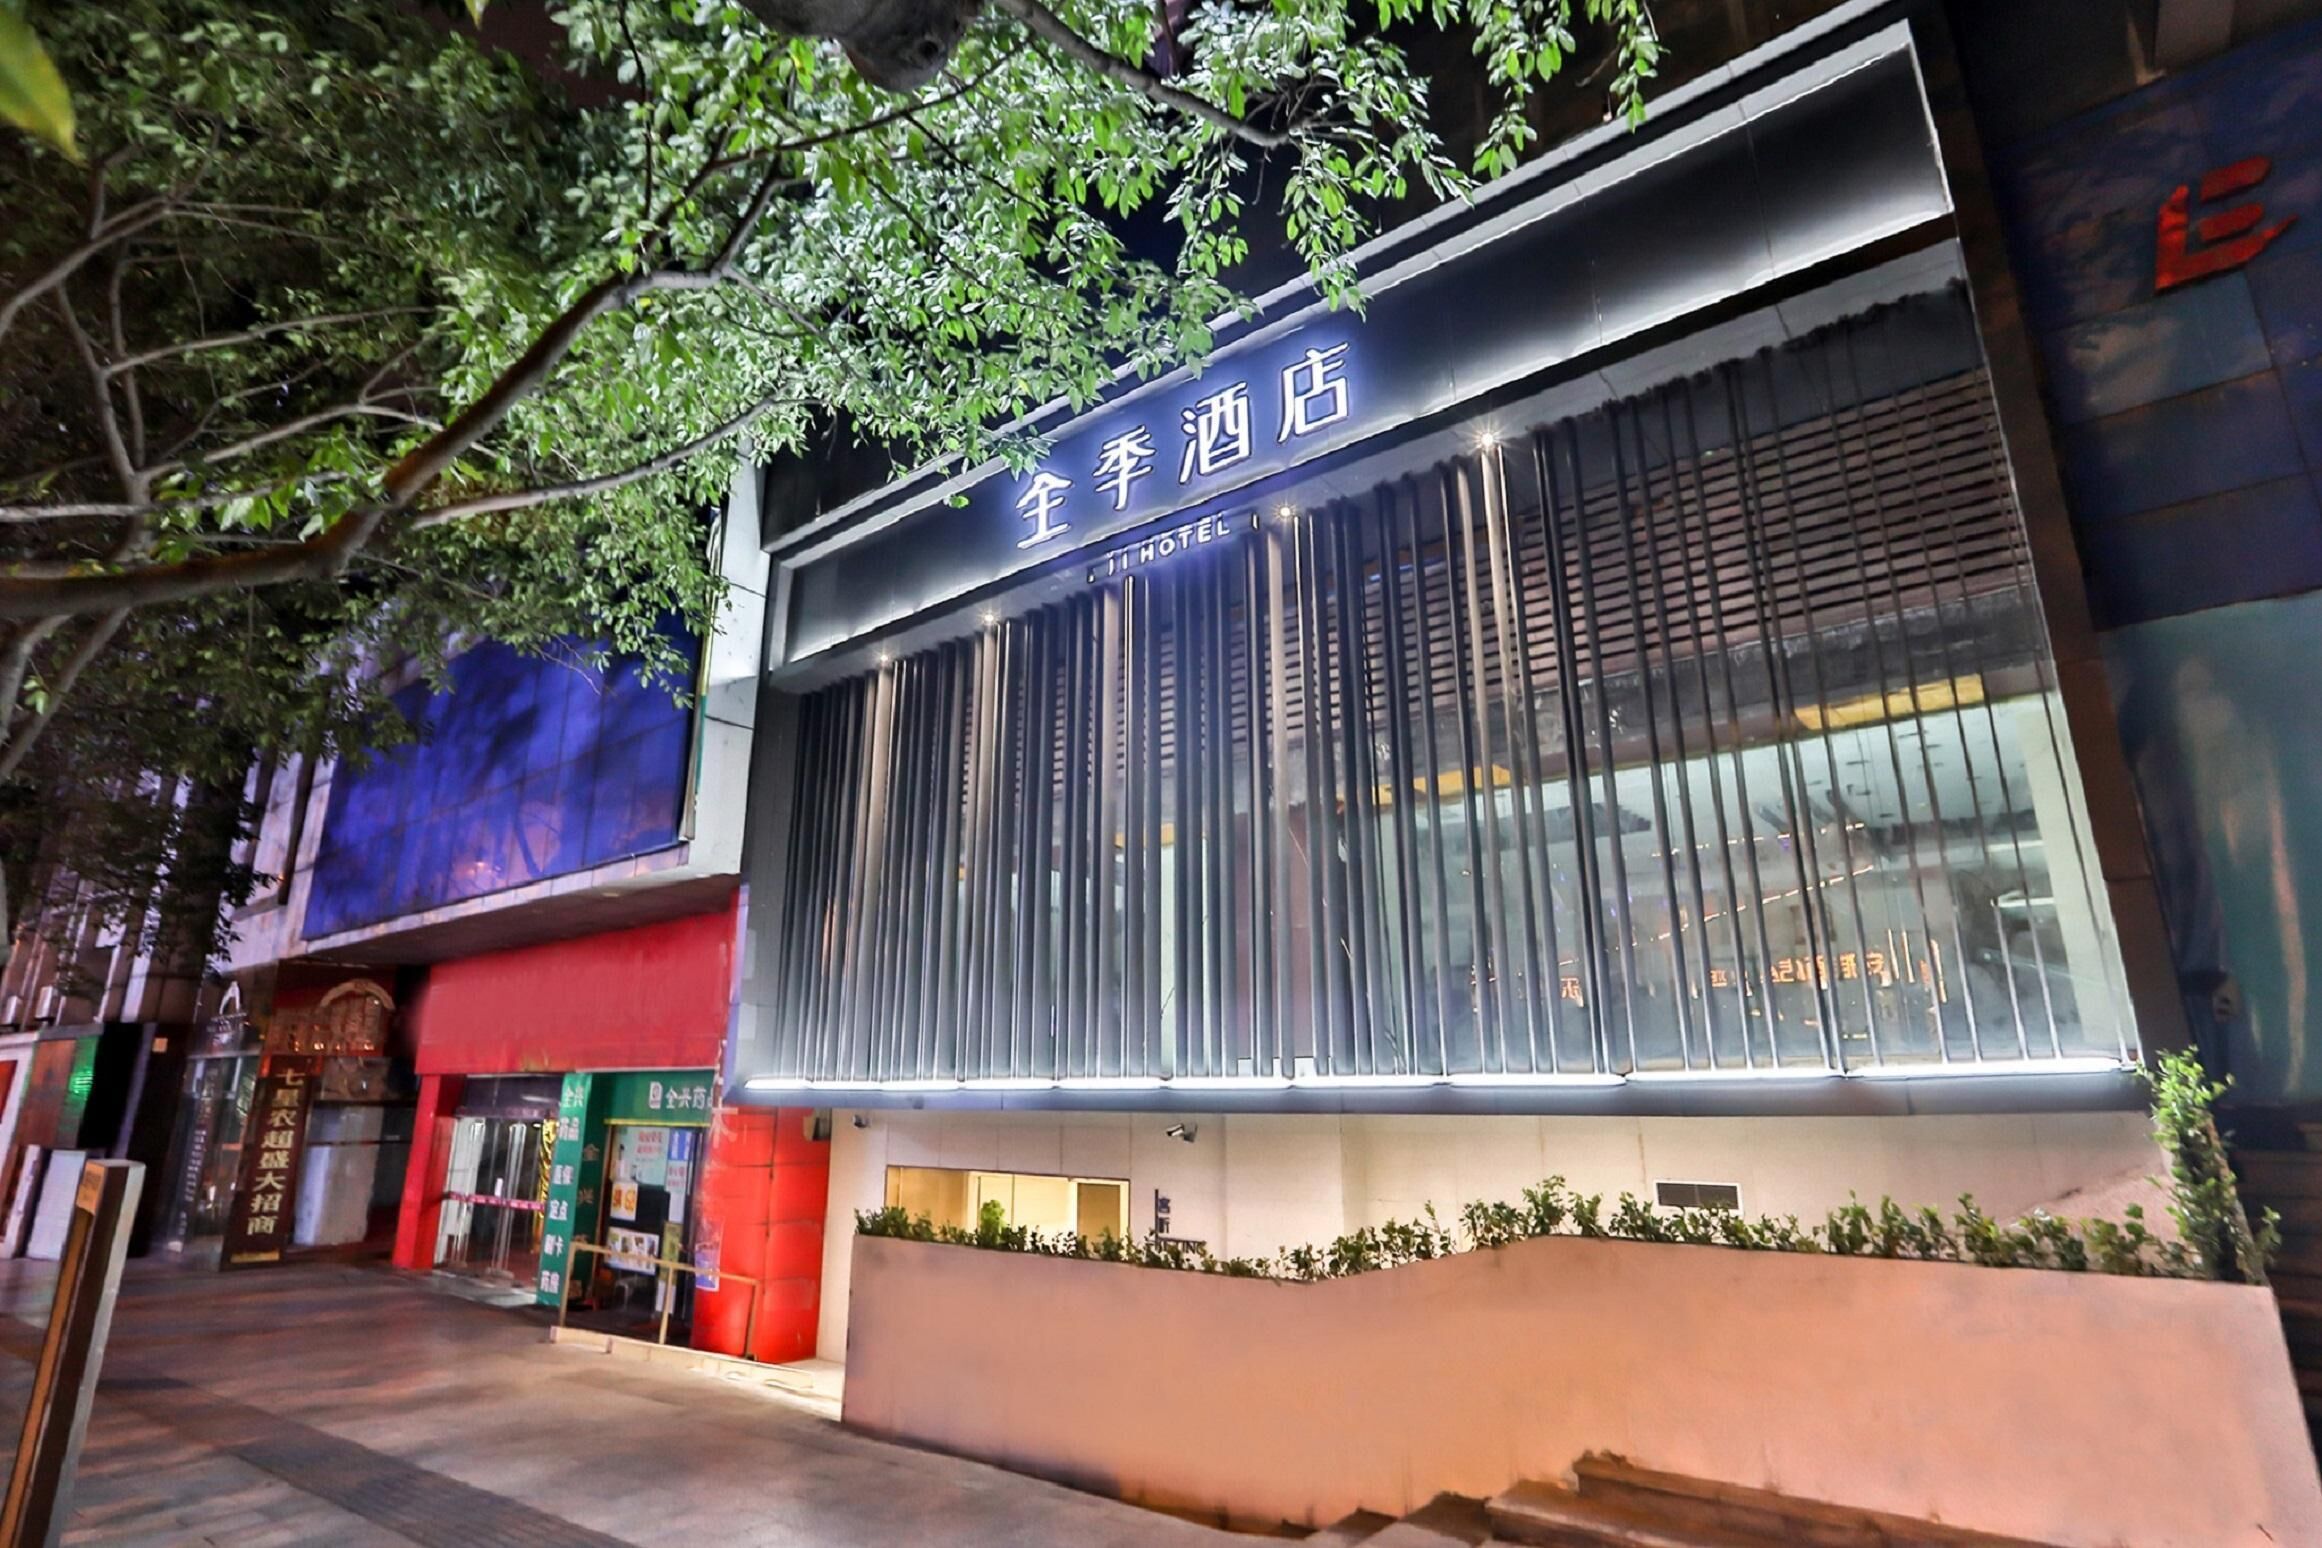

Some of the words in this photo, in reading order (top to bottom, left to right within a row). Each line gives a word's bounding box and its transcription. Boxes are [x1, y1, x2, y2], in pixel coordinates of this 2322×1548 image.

[1014, 341, 1350, 549] 全季酒店
[1139, 518, 1231, 564] HOTEL
